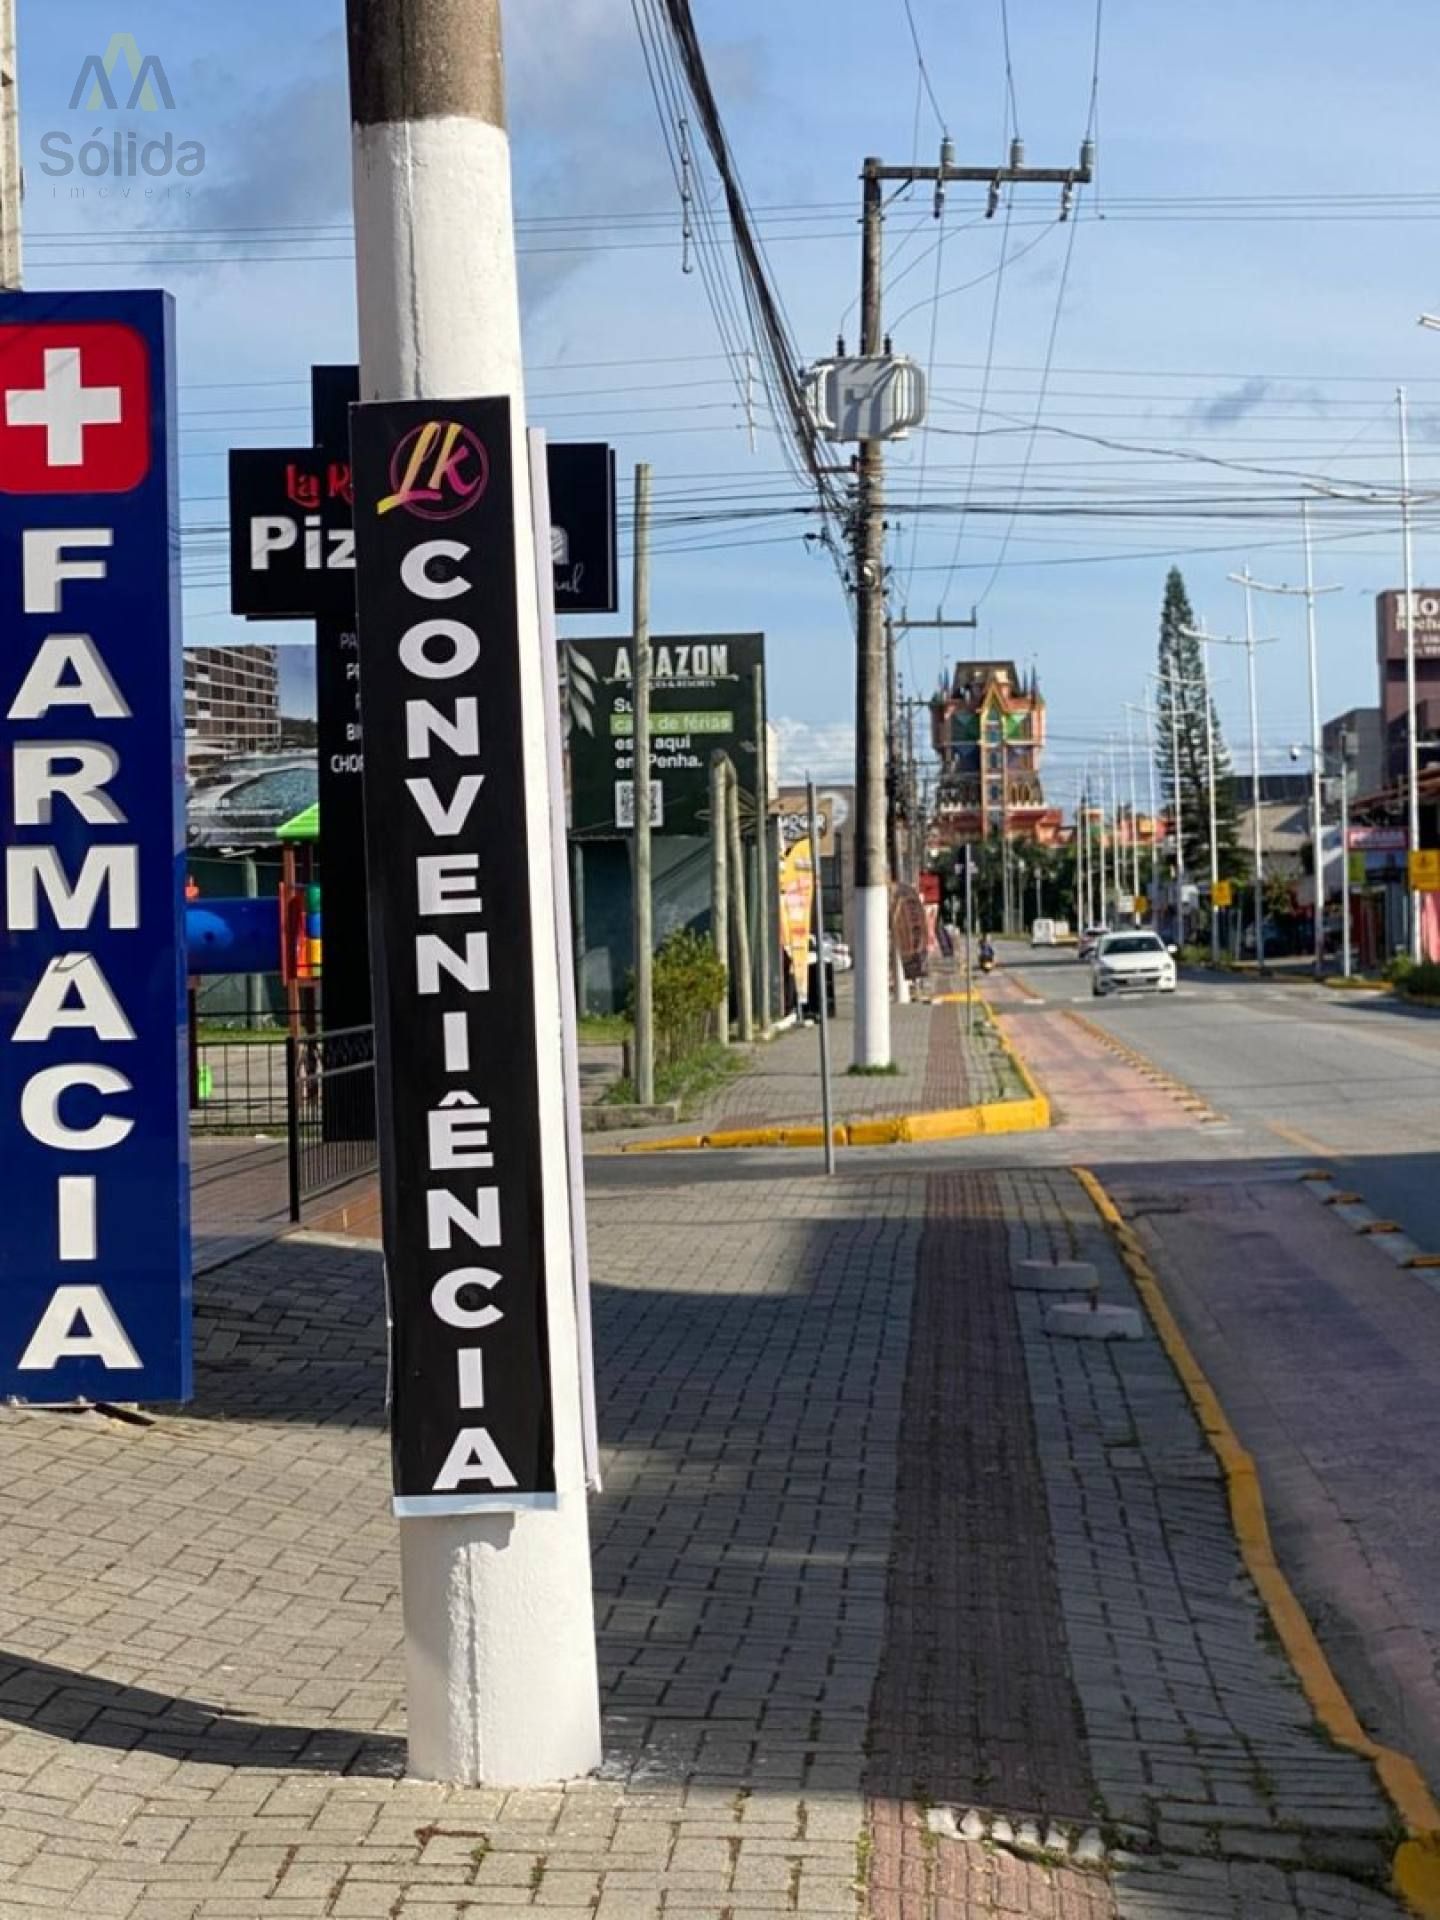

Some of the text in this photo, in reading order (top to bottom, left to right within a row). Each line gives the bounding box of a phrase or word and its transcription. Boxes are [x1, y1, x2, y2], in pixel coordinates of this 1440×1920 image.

[326, 463, 353, 506] R
[250, 515, 356, 569] Piz
[655, 734, 691, 752] aqui
[683, 714, 730, 730] férias
[6, 528, 144, 1370] FARMACIA
[398, 538, 519, 1491] CONVENIÊNCIA
